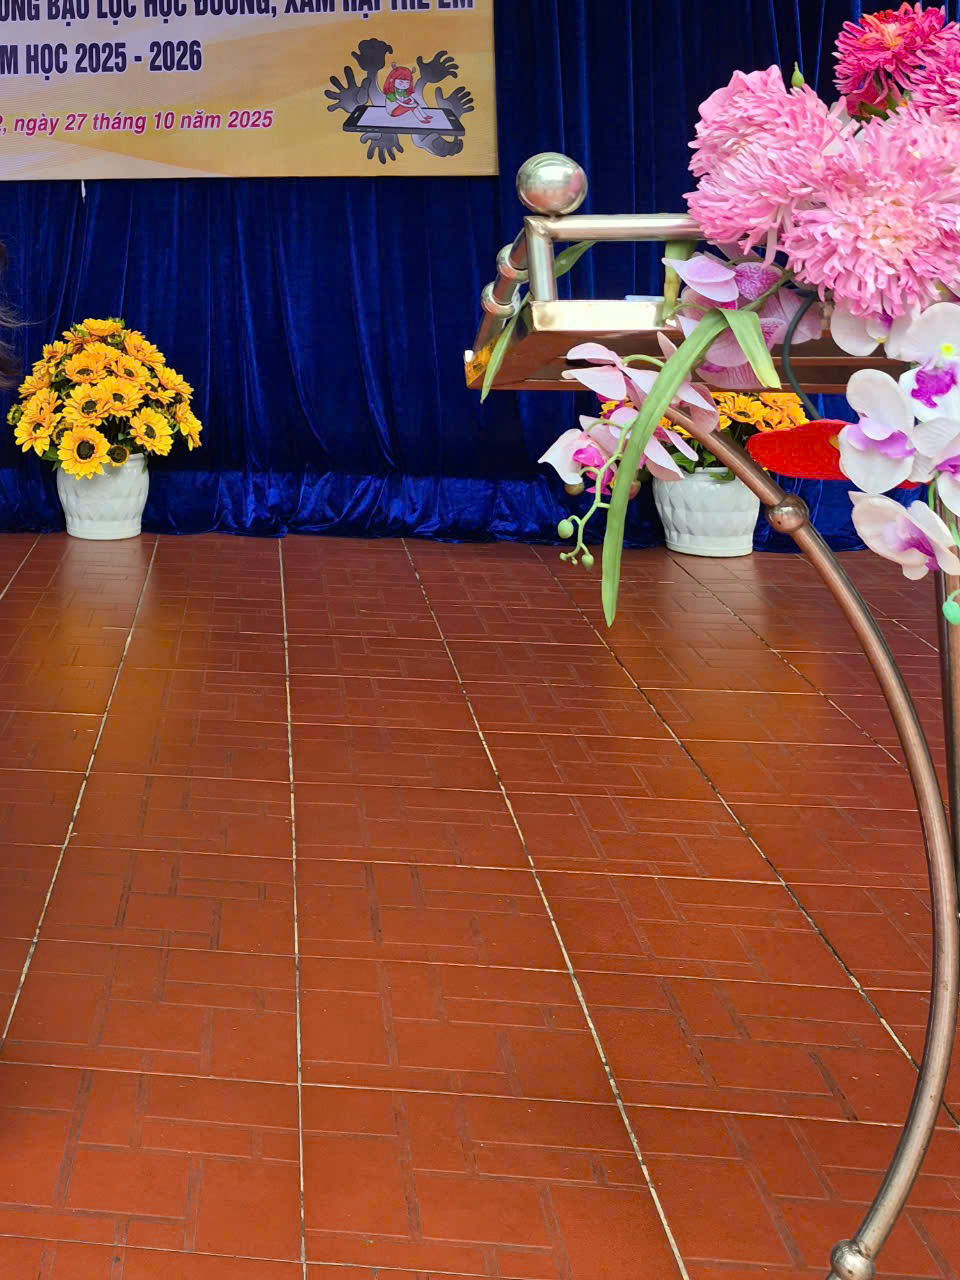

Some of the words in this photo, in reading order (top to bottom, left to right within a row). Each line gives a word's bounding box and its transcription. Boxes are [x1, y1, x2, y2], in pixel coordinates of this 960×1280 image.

[26, 43, 68, 81] HỌC
[75, 42, 127, 73] 2025
[149, 39, 202, 72] 2026
[14, 117, 59, 137] ngày
[64, 113, 87, 131] 27
[93, 112, 147, 135] tháng
[155, 111, 175, 130] 10
[180, 111, 221, 130] năm
[227, 110, 273, 129] 2025
